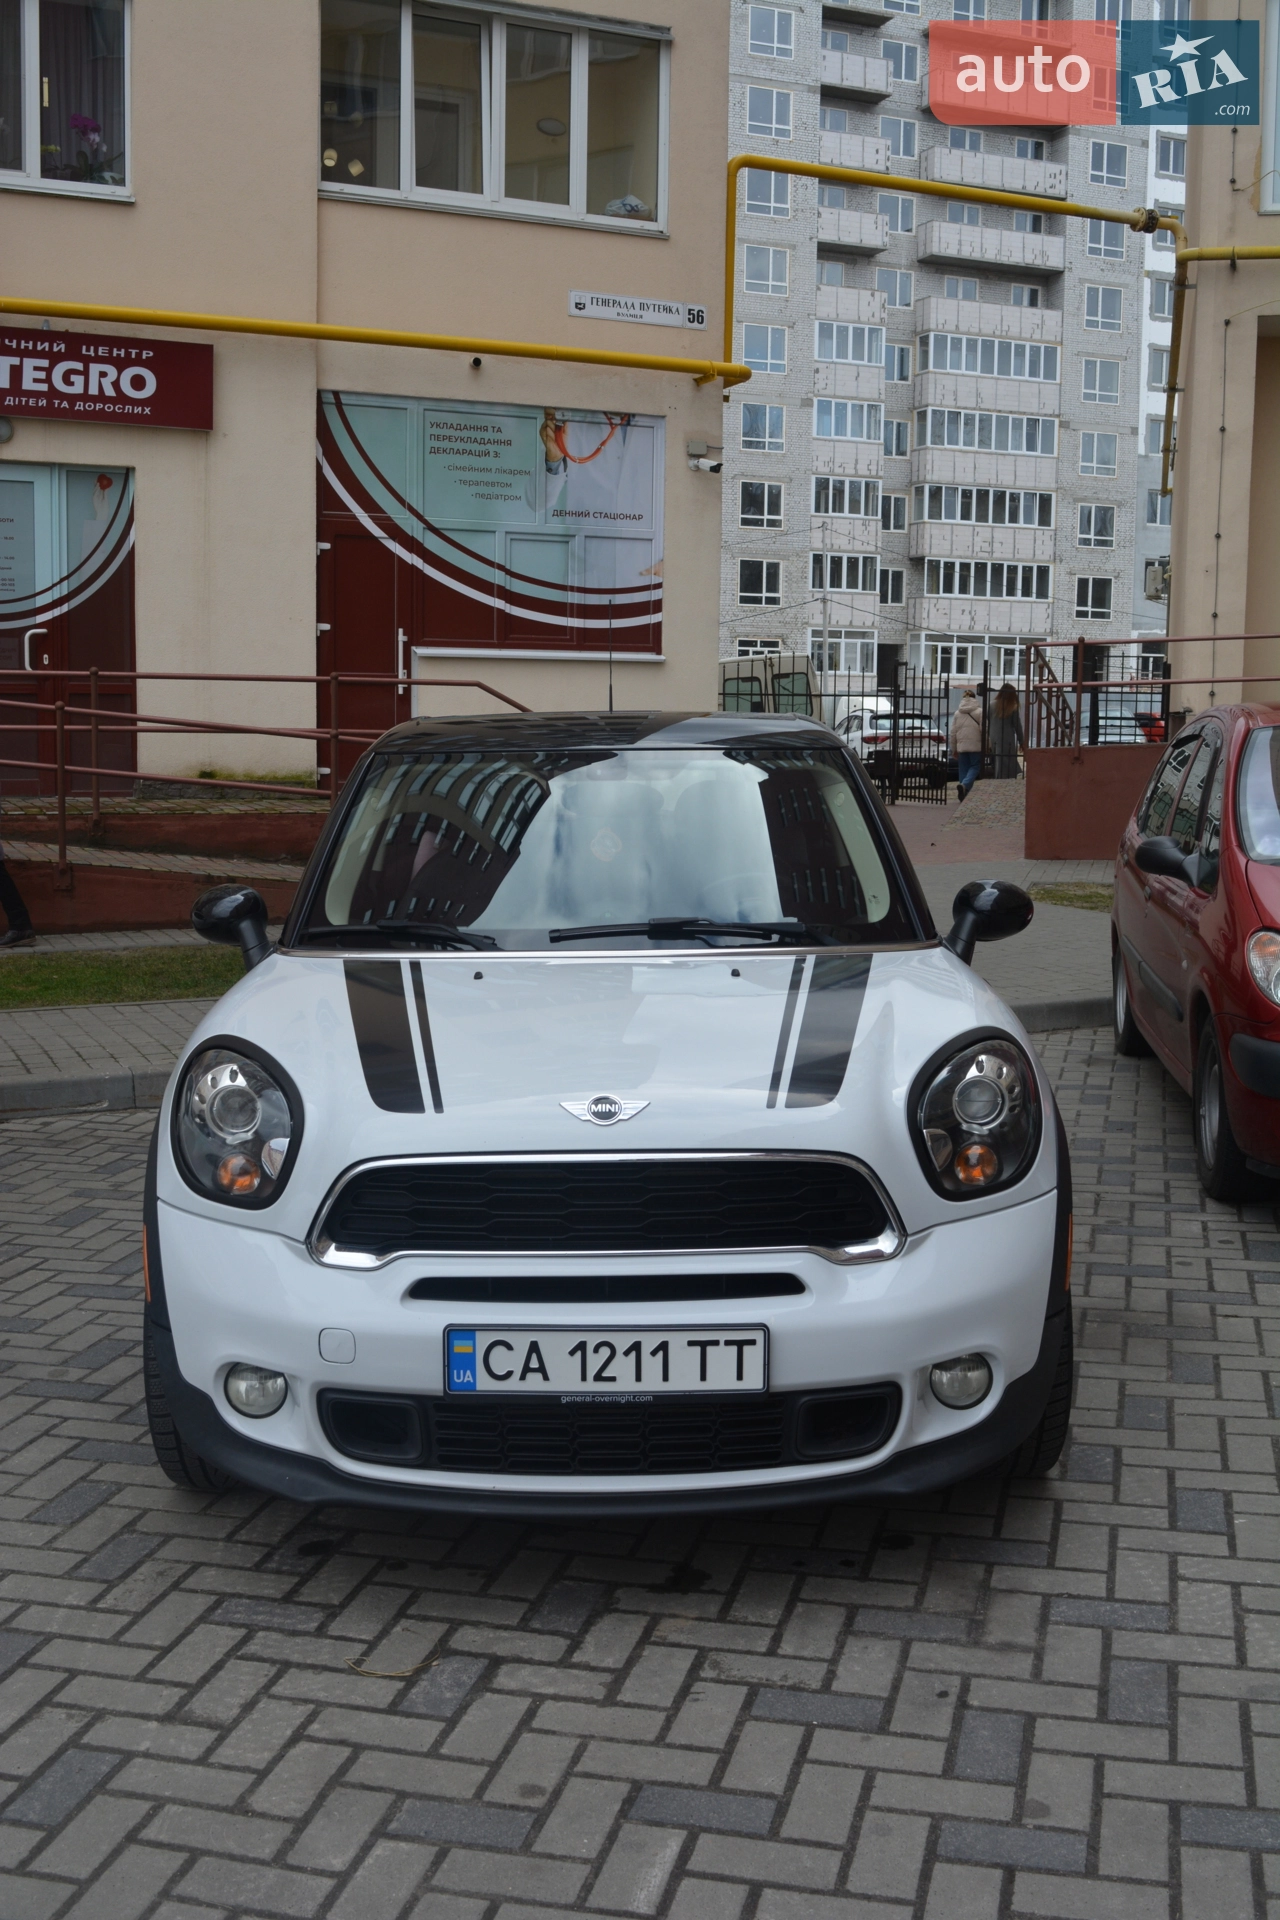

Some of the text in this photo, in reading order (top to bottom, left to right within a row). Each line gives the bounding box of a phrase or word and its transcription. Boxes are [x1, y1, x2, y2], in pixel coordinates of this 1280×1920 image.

[590, 296, 681, 316] ГЕНЕРАЛА ПУТЕЙКА
[687, 308, 705, 325] 56
[0, 338, 154, 360] ЧНИЙ ЦЕНТР
[0, 355, 157, 399] TEGRO
[4, 396, 152, 415] ДІТЕЙ ТА ДОРОСЛИХ
[429, 421, 503, 434] УКЛАДАННЯ ТА
[429, 433, 512, 447] ПЕРЕУКЛАДАННЯ
[429, 446, 491, 458] ДЕКЛАРАЦІЙ
[447, 463, 531, 477] сімейним лікарем
[458, 479, 512, 489] терапевтом
[474, 492, 522, 502] педіатром
[552, 509, 644, 522] ДЕННИЙ СТАЦІОНАР
[590, 1103, 619, 1113] MINI
[482, 1338, 757, 1383] CA 1211 TT
[453, 1370, 474, 1383] UA
[560, 1394, 654, 1404] general-overnight.com
